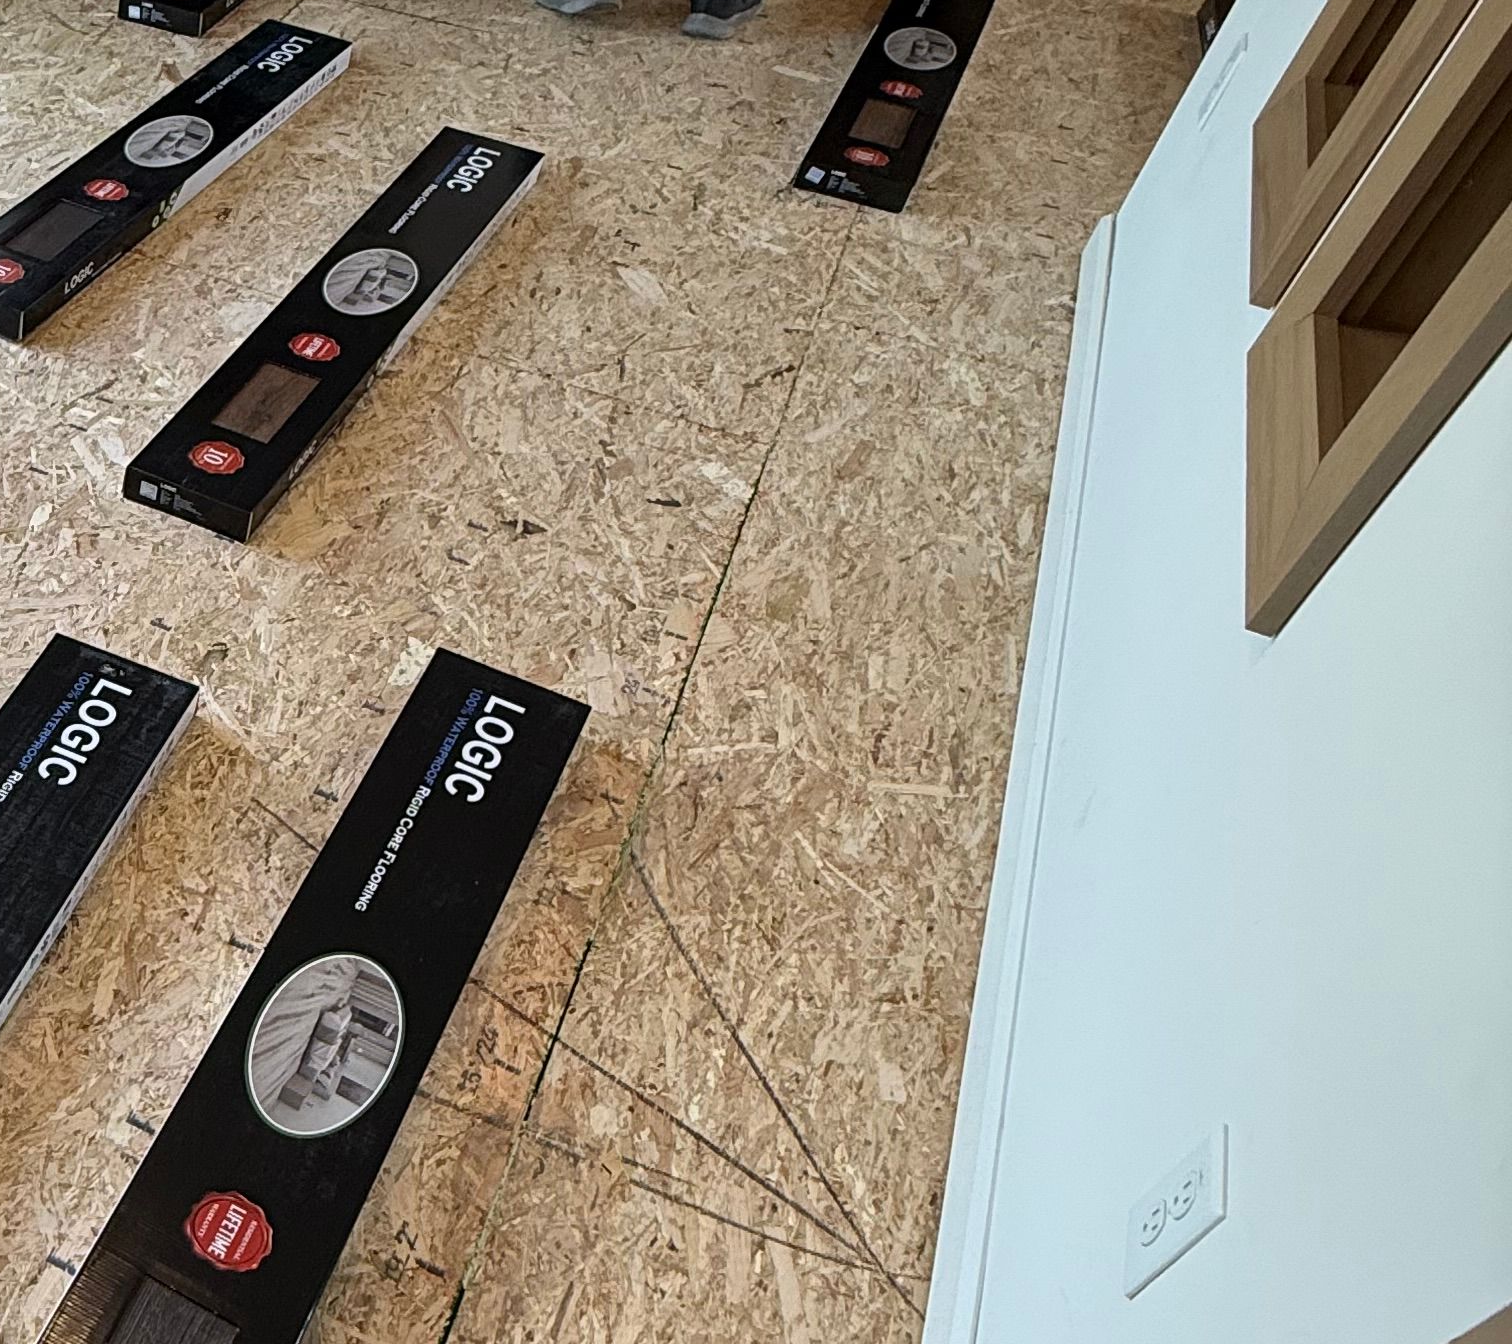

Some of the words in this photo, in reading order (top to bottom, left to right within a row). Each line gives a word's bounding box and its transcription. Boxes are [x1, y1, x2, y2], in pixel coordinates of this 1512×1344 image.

[257, 36, 314, 73] LOGIC
[446, 146, 502, 193] LOGIC
[64, 261, 94, 294] LOGIC
[203, 447, 229, 465] 10
[67, 671, 94, 698] 100%
[19, 699, 73, 771] WATERPROOF
[38, 678, 133, 786] LOGIC
[424, 716, 469, 787] WATERPROOF
[444, 694, 526, 803] LOGIC
[405, 784, 432, 818] RIGID
[386, 817, 414, 852] CORE
[354, 849, 397, 912] FLOORING
[207, 1203, 248, 1260] LIFETIME
